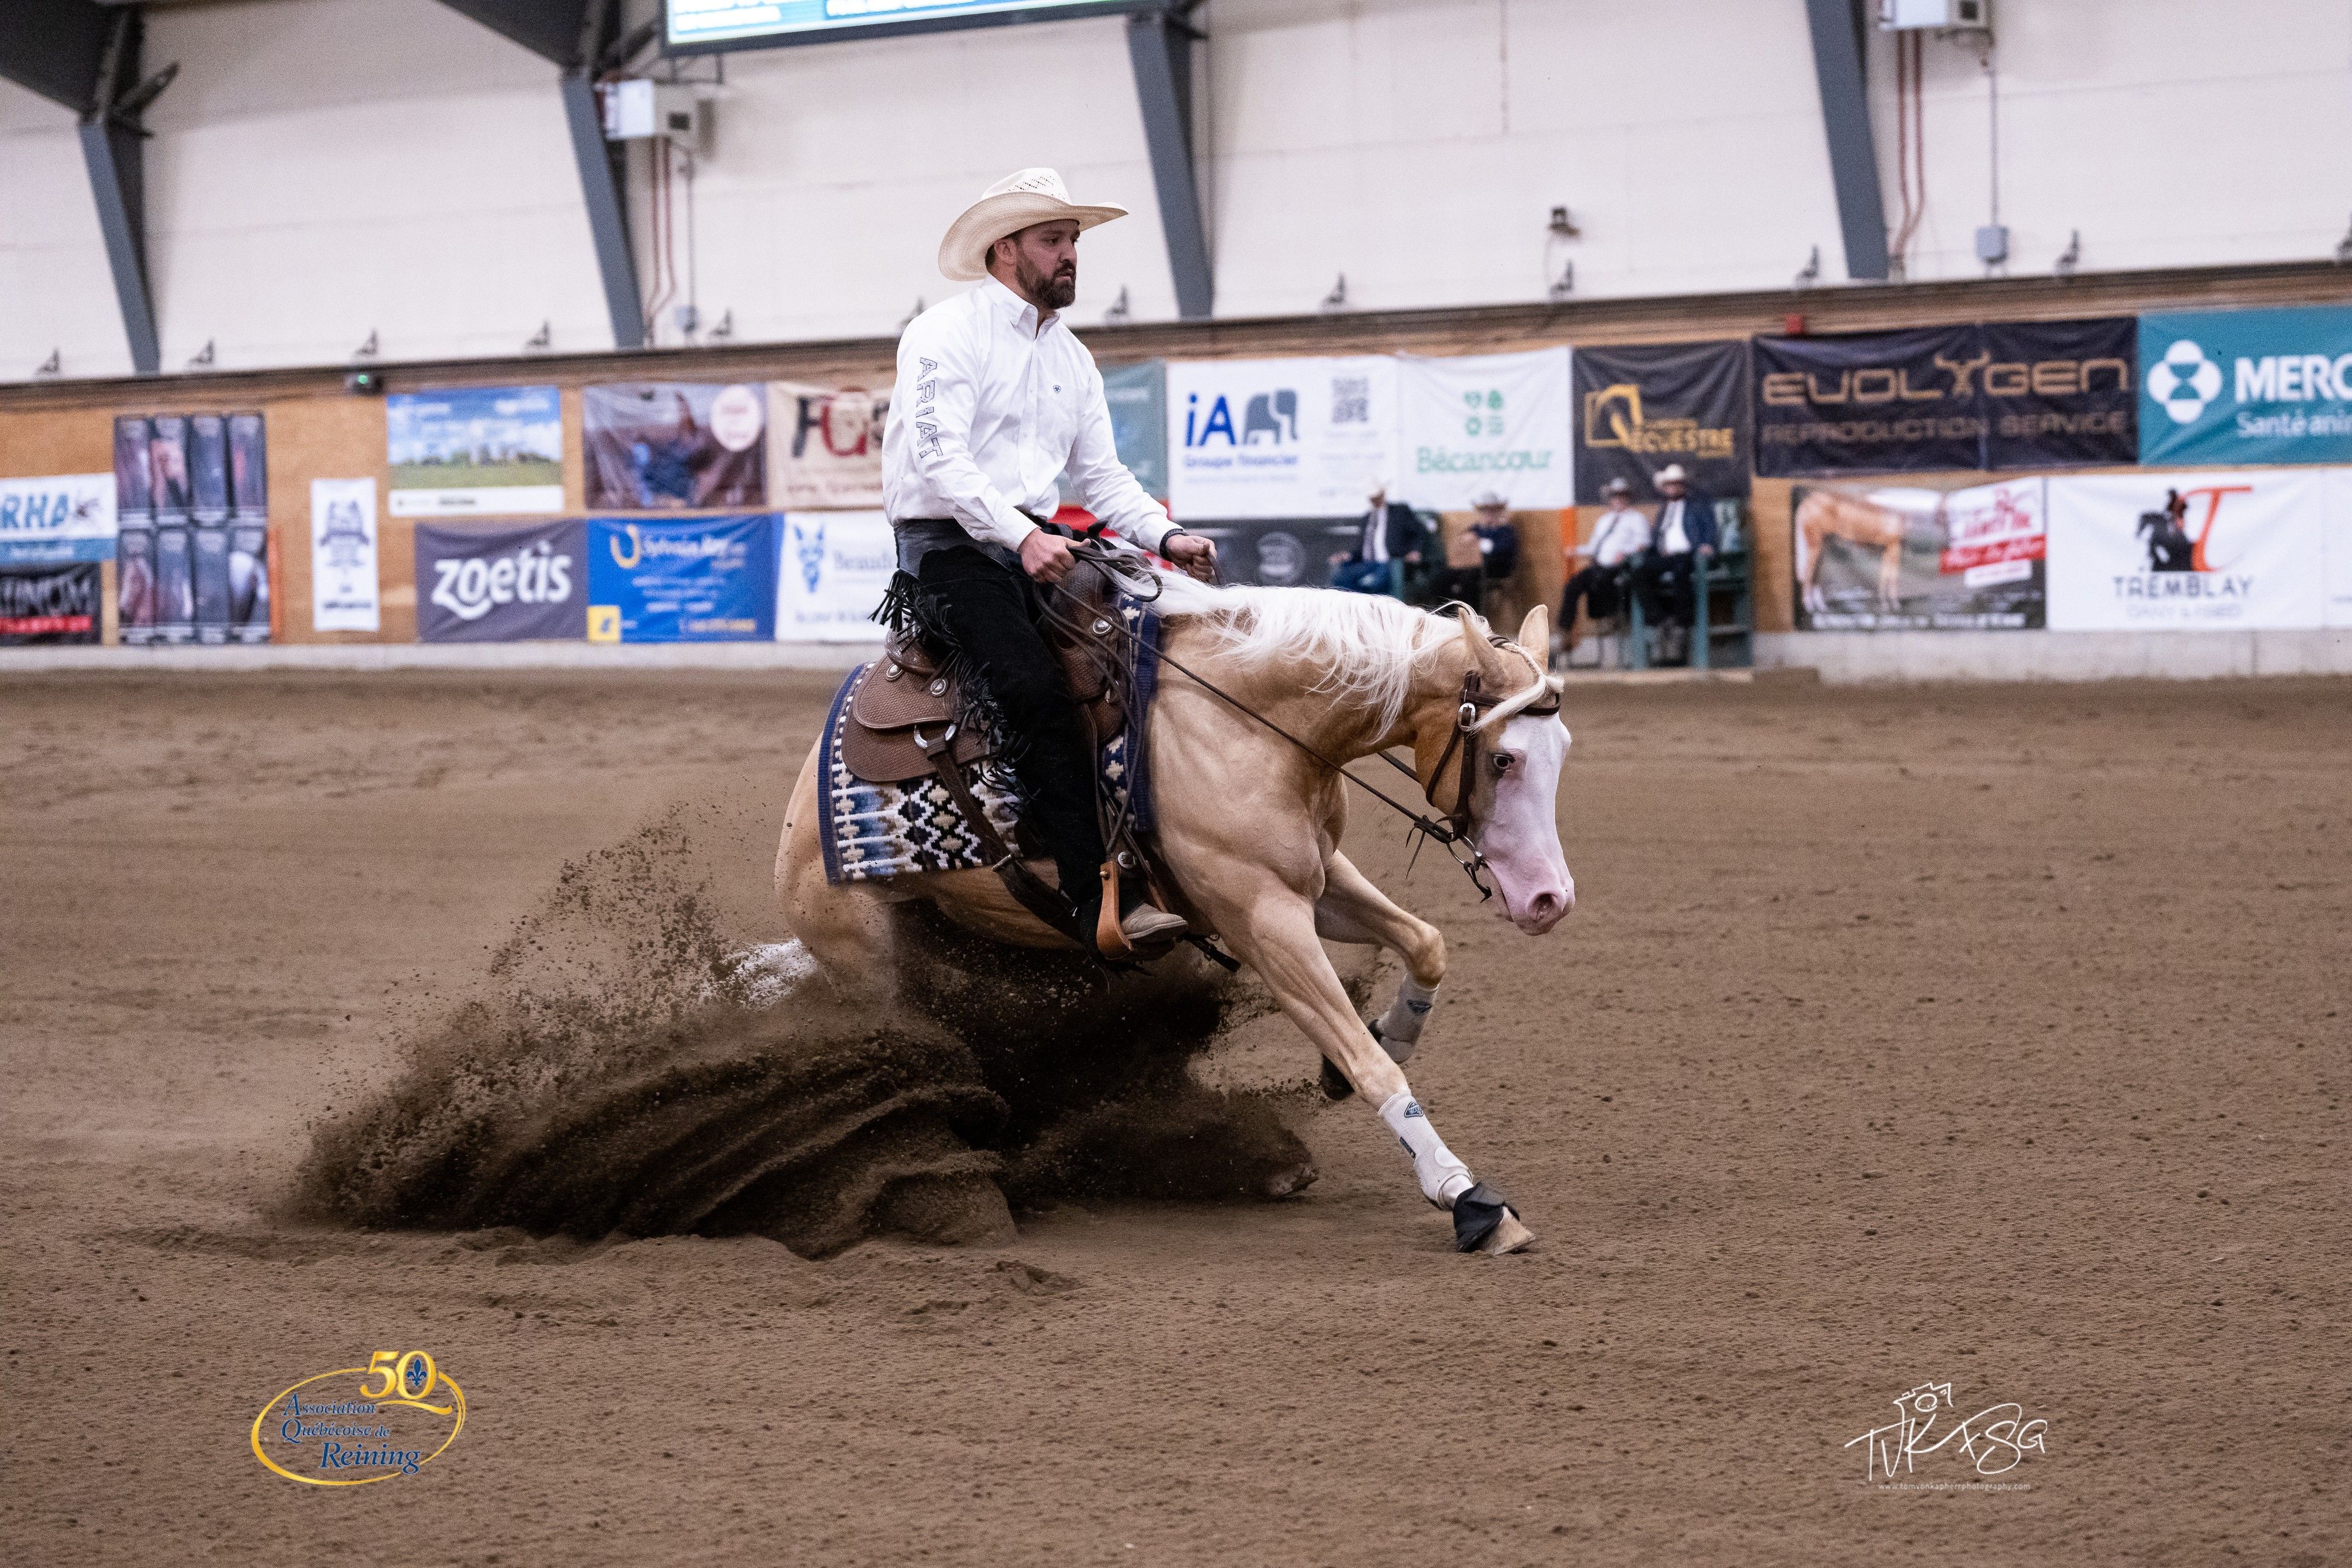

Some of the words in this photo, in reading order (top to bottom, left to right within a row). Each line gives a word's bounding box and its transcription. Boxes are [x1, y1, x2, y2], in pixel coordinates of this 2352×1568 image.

[915, 357, 943, 459] ARIAT
[1184, 392, 1237, 447] iA
[2236, 409, 2307, 437] Santé
[2308, 409, 2352, 436] ani
[1763, 415, 1989, 446] REPRODUCTION
[2000, 410, 2126, 437] SERVICE
[1183, 454, 1234, 469] Groupe
[1416, 445, 1552, 474] Bécancour
[432, 540, 572, 620] zoetis
[2112, 575, 2254, 599] TREMBLAY
